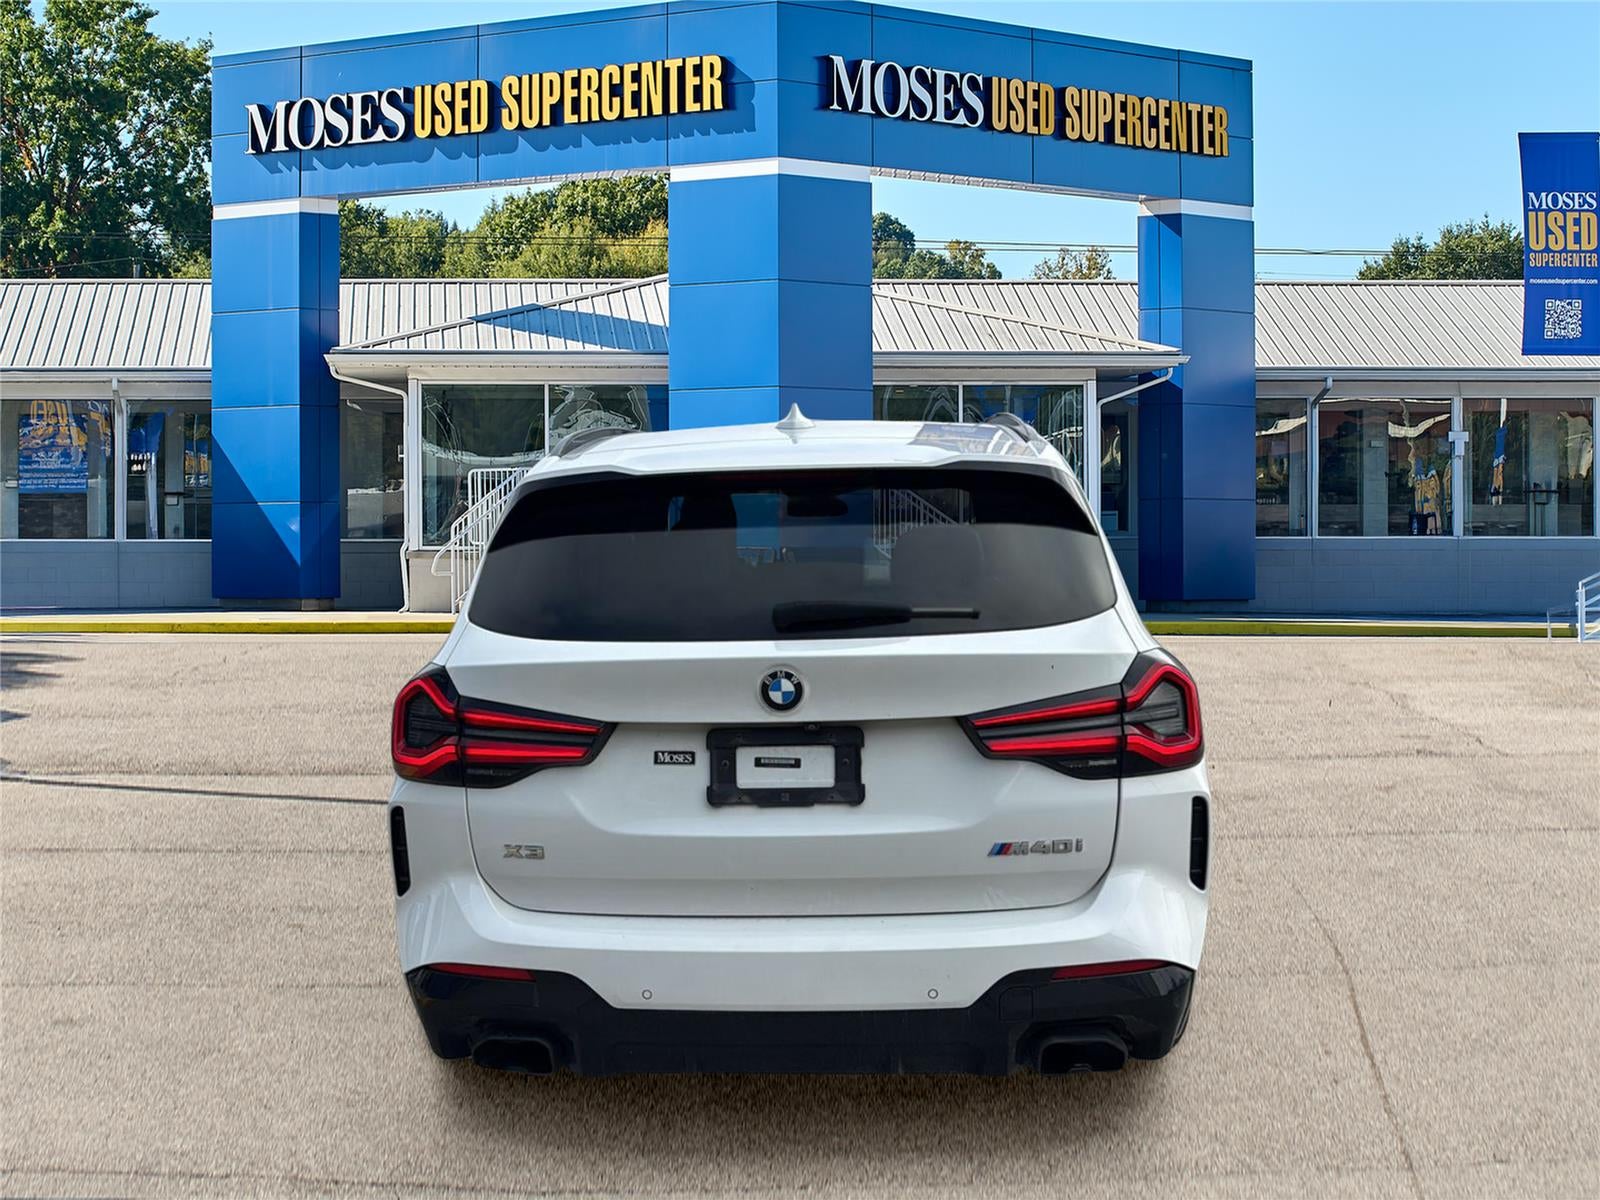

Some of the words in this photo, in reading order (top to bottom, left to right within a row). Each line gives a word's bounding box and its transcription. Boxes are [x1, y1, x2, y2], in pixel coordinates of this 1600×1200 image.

[244, 88, 407, 154] MOSES
[413, 80, 488, 138] USED
[501, 54, 723, 130] SUPERCENTER
[828, 55, 984, 128] MOSES
[991, 77, 1055, 136] USED
[1064, 86, 1229, 156] SUPERCENTER
[1527, 191, 1597, 210] MOSES
[1528, 211, 1598, 251] USED
[1529, 252, 1598, 267] SUPERCENTER
[764, 670, 800, 685] BMW
[657, 752, 692, 763] MOSES
[503, 844, 545, 860] X3
